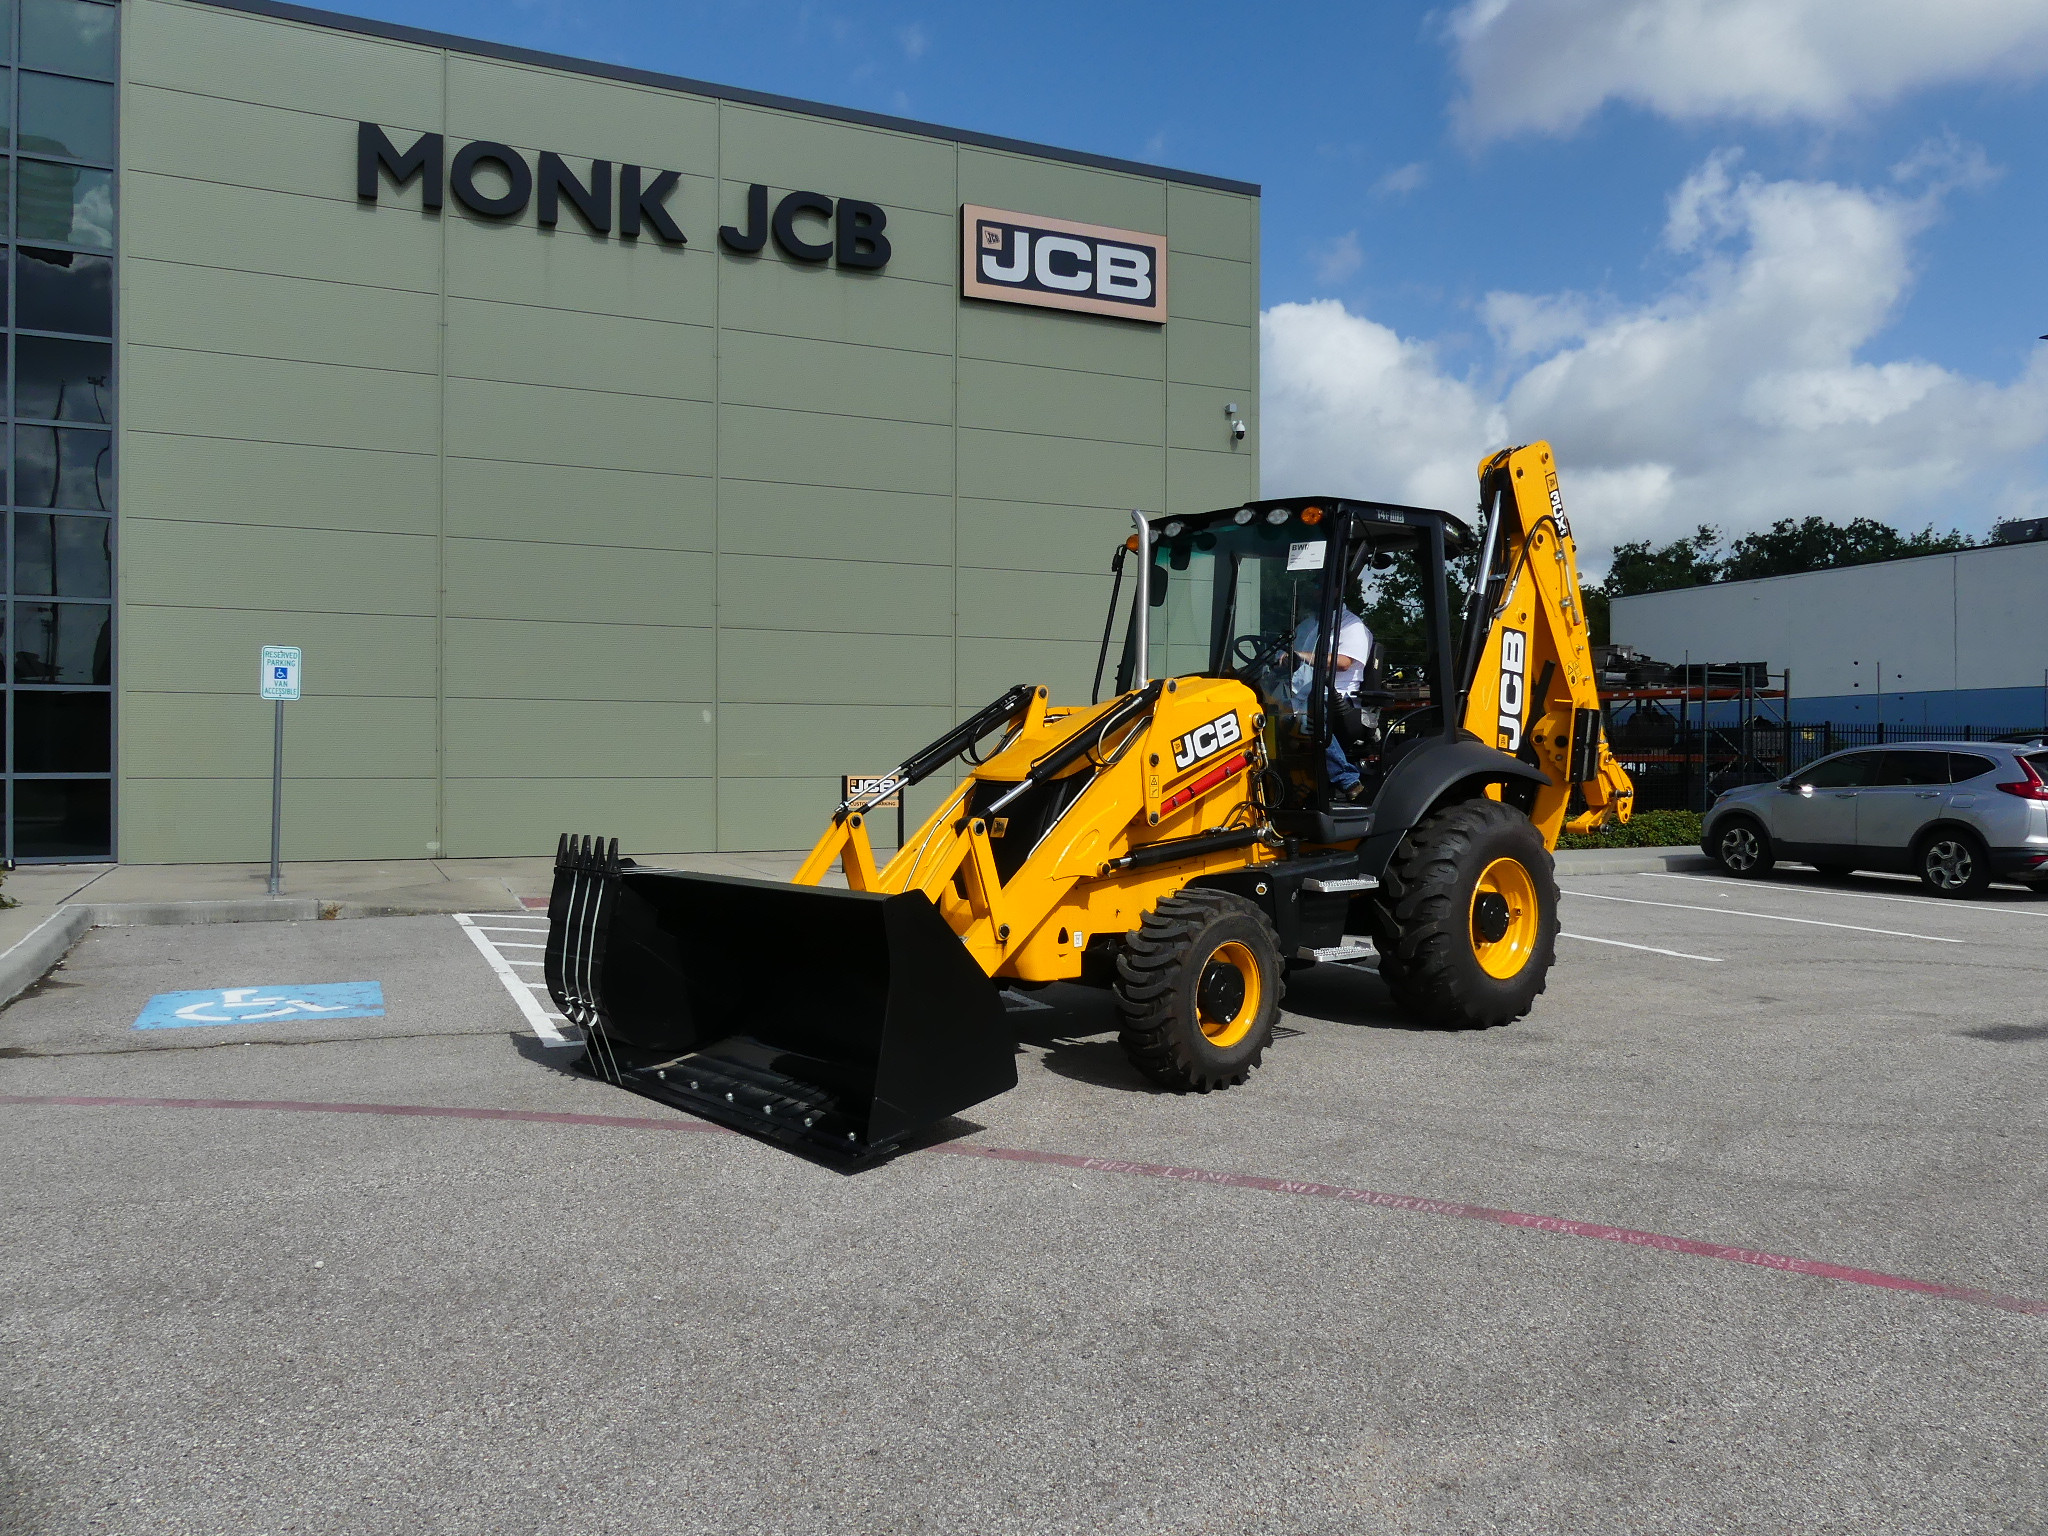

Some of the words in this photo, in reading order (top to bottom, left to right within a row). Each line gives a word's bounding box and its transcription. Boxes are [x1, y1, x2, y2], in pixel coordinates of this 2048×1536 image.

[358, 121, 687, 243] MONK
[719, 184, 891, 269] JCB
[982, 230, 1151, 300] JCB
[1550, 490, 1567, 531] 3CX
[265, 651, 297, 659] RESERVED
[267, 659, 296, 667] PARKING
[1499, 631, 1524, 751] JCB
[1176, 713, 1240, 767] JCB
[851, 780, 895, 792] JCB
